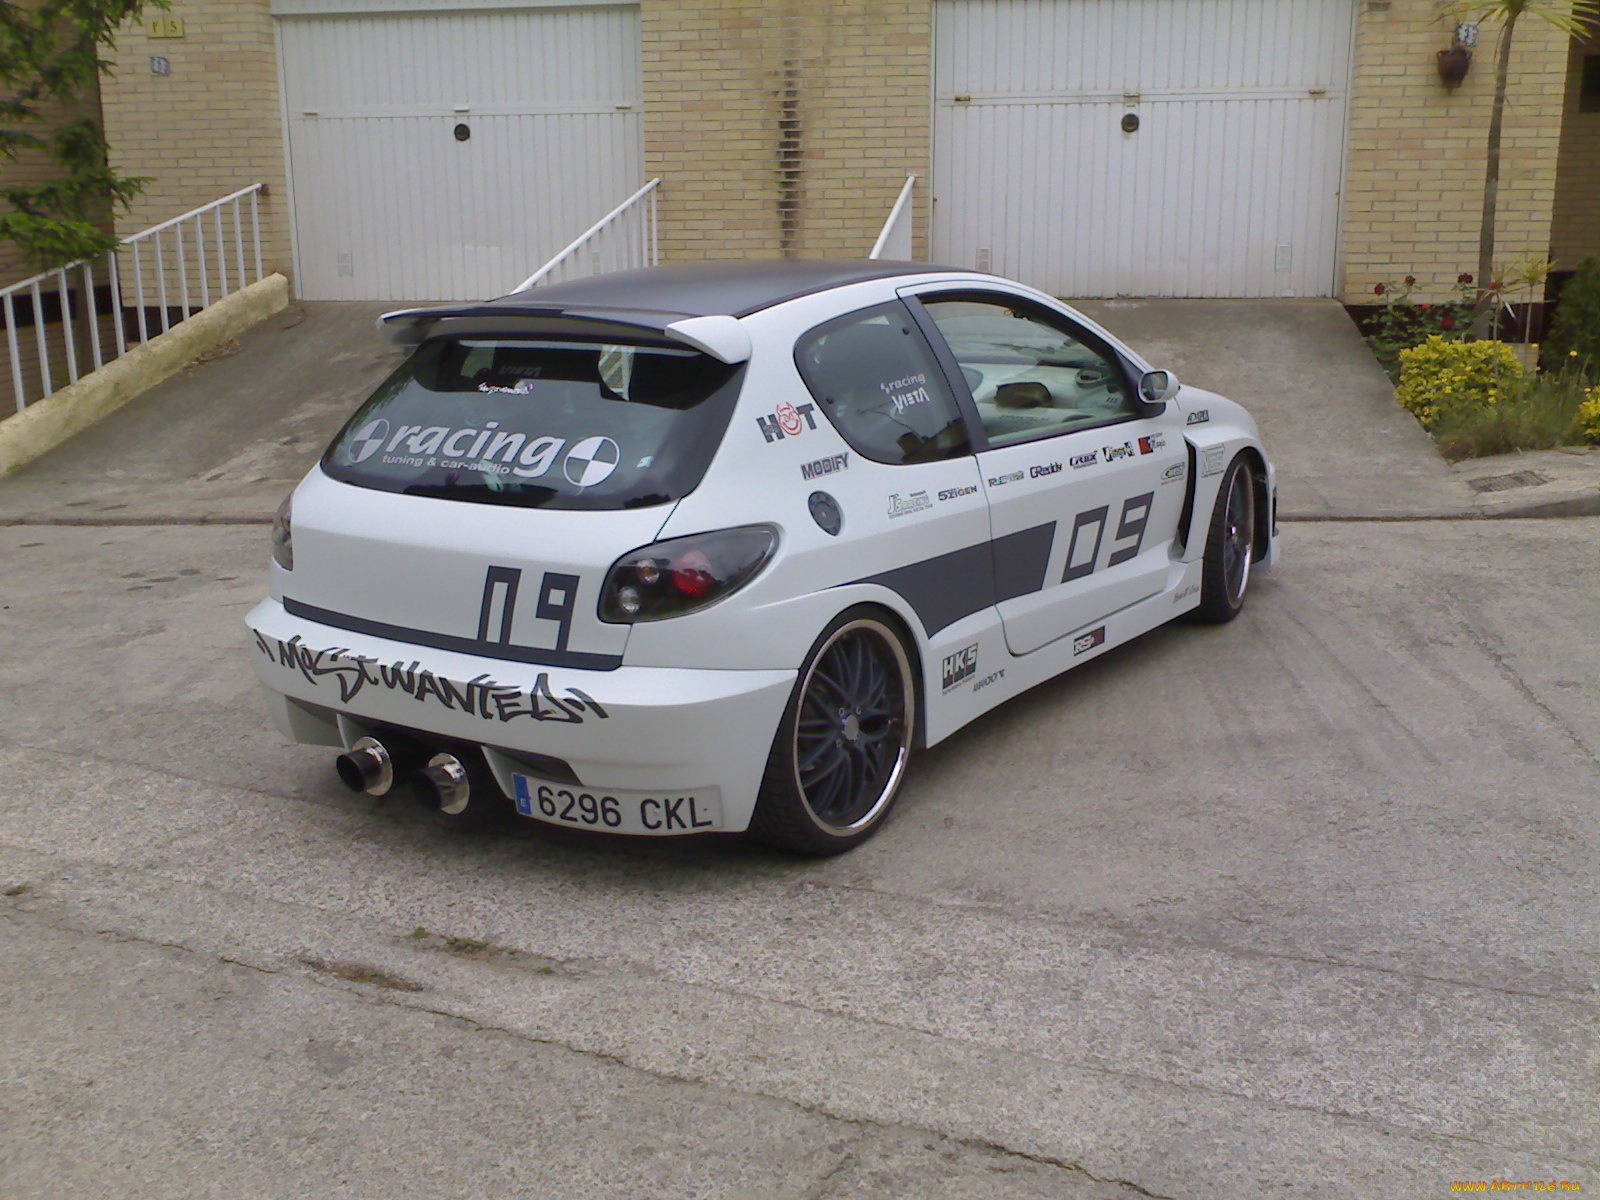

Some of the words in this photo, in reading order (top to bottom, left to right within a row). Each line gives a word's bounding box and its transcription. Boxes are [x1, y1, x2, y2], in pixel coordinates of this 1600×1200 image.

[889, 374, 926, 390] racing
[382, 453, 423, 468] tuning
[426, 457, 437, 467] &
[440, 459, 511, 475] car-audio
[386, 420, 567, 478] racing
[800, 451, 850, 481] MODIFY
[1061, 491, 1155, 584] 09
[477, 564, 581, 652] 09
[943, 644, 978, 682] HKS
[538, 785, 622, 828] 6296
[640, 796, 714, 830] CKL
